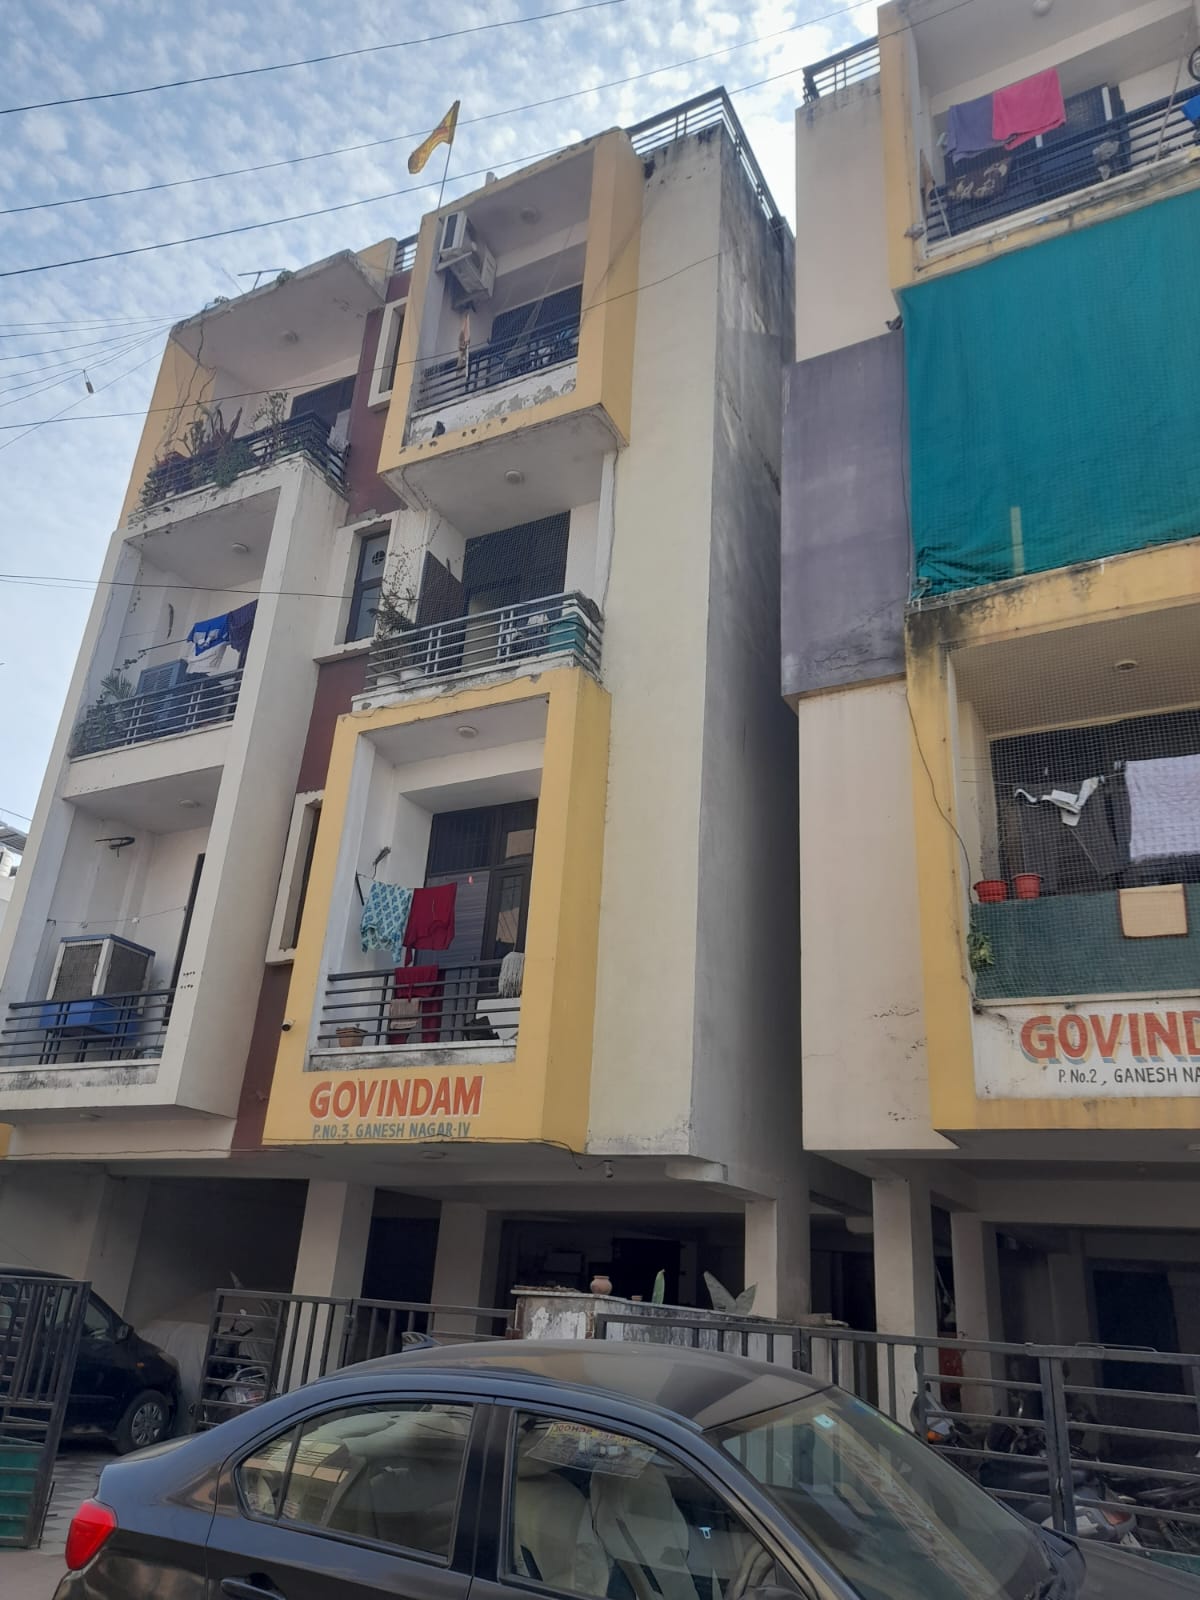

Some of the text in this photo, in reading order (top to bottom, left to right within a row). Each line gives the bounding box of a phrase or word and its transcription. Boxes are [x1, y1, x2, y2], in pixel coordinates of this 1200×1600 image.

[1114, 1067, 1178, 1084] GANESH
[309, 1076, 483, 1119] GOVINDAM
[356, 1123, 405, 1138] GANESH
